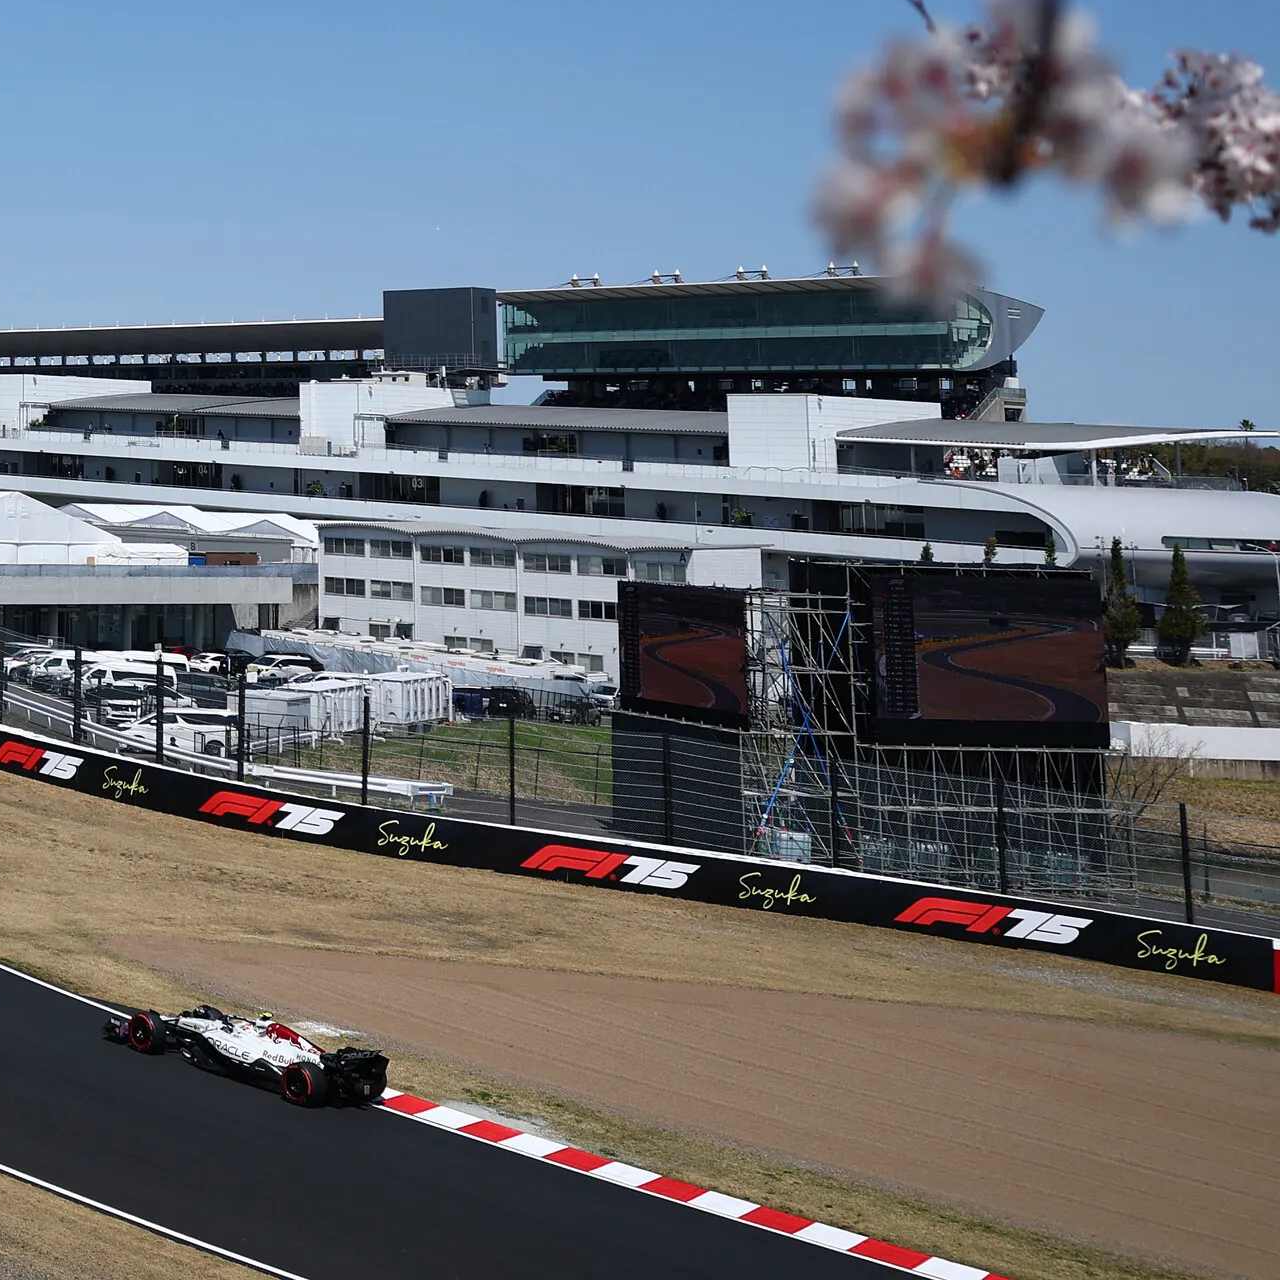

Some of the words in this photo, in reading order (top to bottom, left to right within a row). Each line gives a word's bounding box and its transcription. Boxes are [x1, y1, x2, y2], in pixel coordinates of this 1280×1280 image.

[412, 478, 422, 488] 03
[190, 542, 196, 551] B
[679, 552, 686, 562] A
[102, 766, 149, 798] Suzuka
[377, 820, 449, 856] Suzuka
[739, 872, 817, 909] Suzuka
[1137, 930, 1226, 970] Suzuka
[207, 1037, 251, 1060] ORACLE
[341, 1051, 379, 1060] ORACLE
